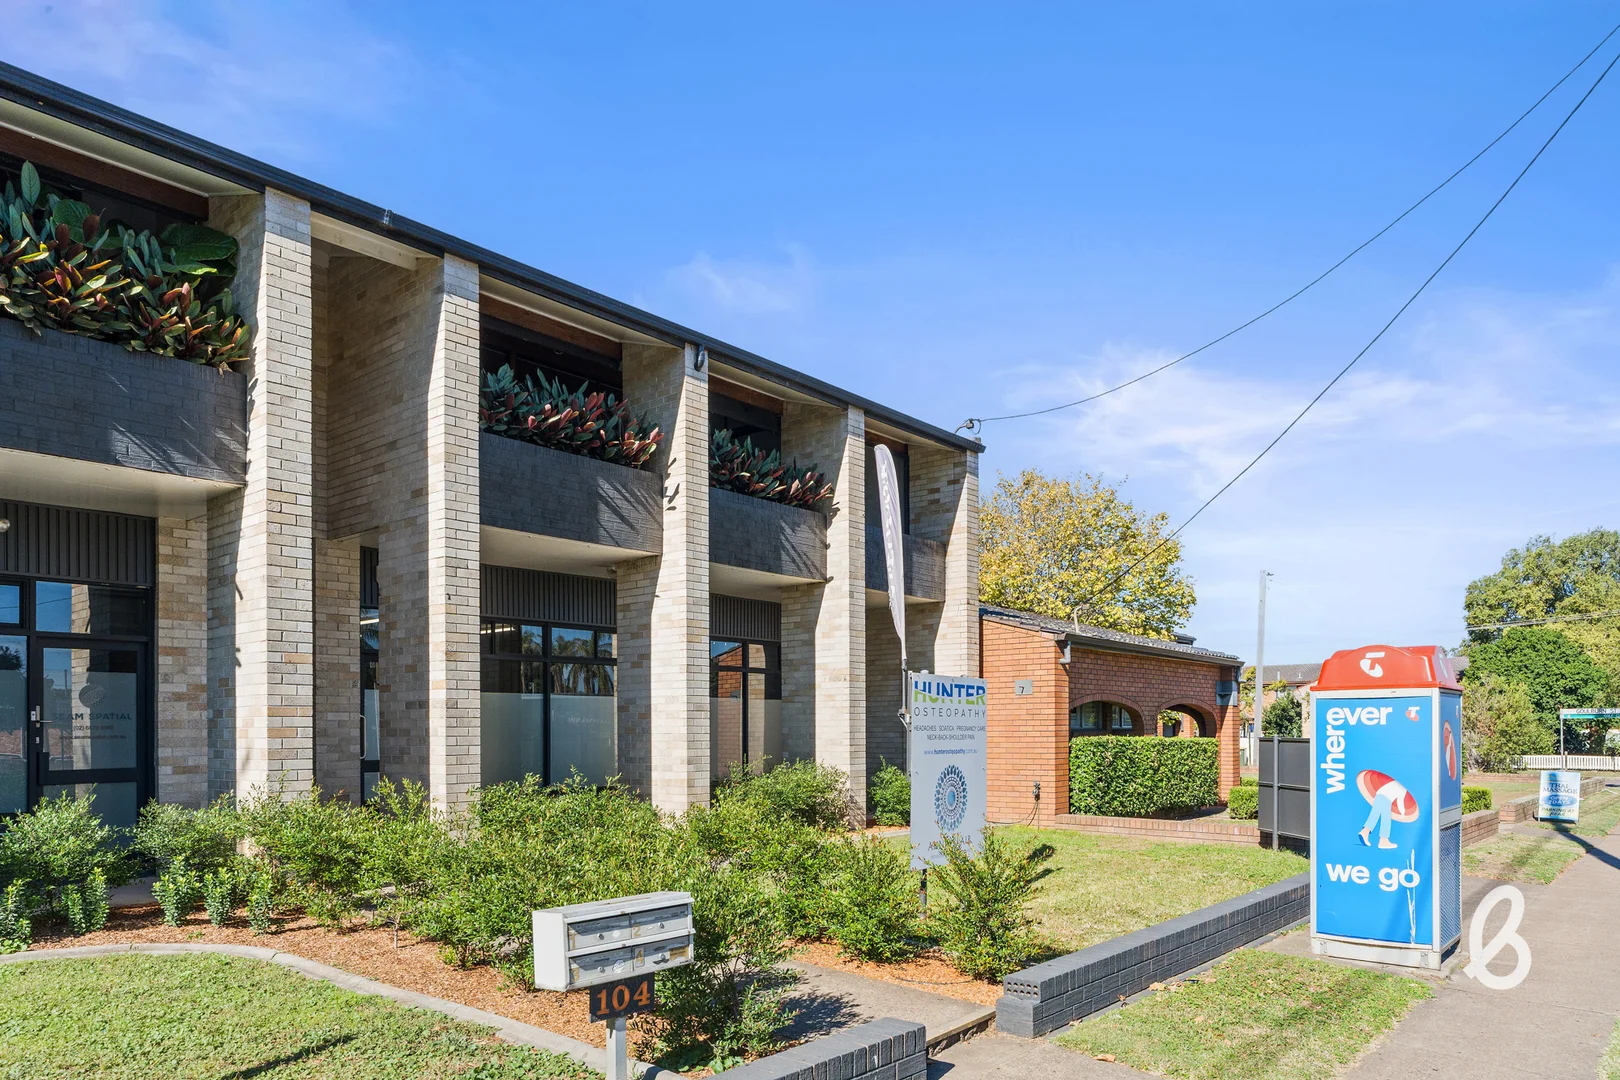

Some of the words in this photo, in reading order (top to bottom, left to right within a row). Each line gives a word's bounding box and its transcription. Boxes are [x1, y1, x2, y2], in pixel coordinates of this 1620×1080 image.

[914, 680, 986, 705] HUNTER
[52, 713, 84, 721] SEAM
[88, 713, 133, 721] SPATIAL
[914, 706, 986, 718] OSTEOPATHY
[914, 724, 936, 732] HEADACHES
[1326, 863, 1370, 884] we
[1378, 867, 1420, 892] go
[633, 925, 641, 937] 2
[571, 967, 580, 982] 3
[635, 949, 644, 965] 4
[596, 980, 651, 1015] 104
